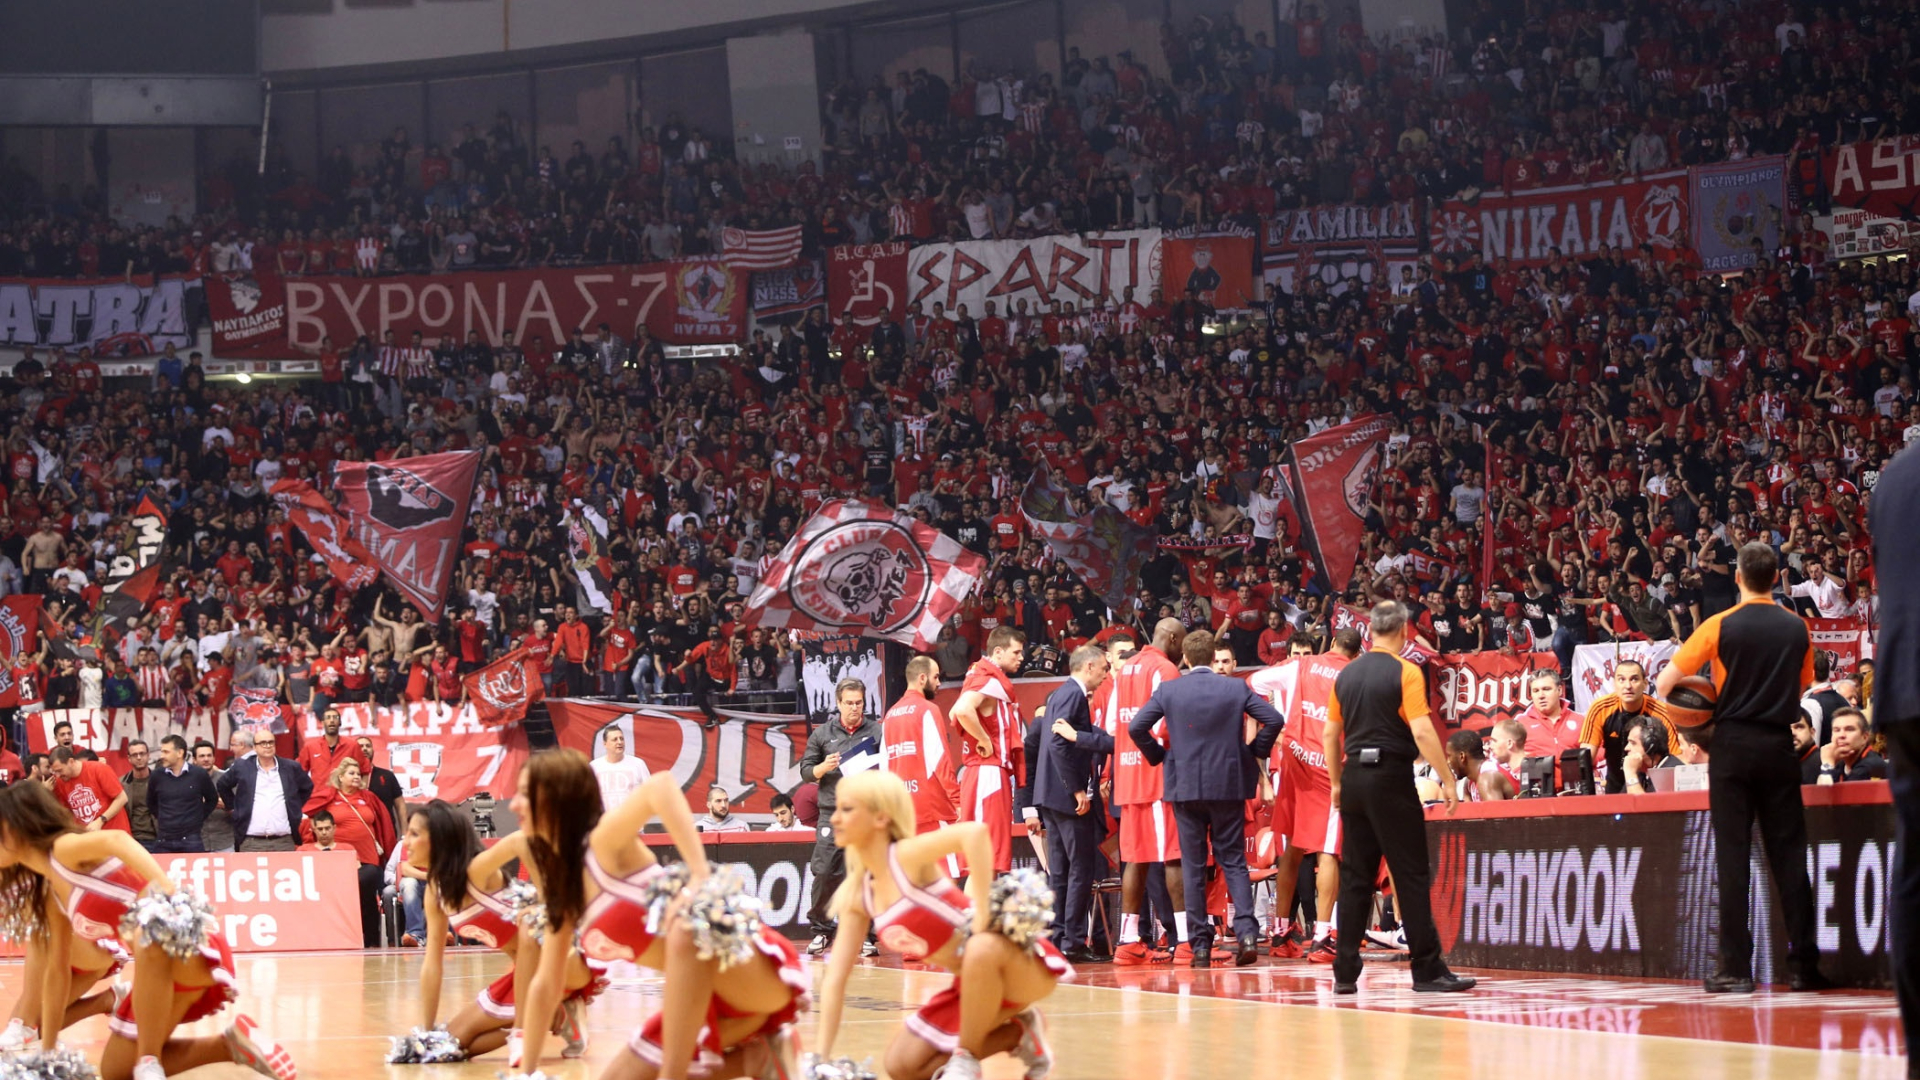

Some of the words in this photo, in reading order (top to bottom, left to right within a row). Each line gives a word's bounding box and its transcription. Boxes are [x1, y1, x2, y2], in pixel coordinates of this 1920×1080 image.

[1267, 203, 1417, 248] FAMILIA
[754, 286, 798, 302] NESS
[1310, 663, 1340, 680] DARDE
[476, 745, 508, 787] 7
[167, 856, 321, 903] fficial
